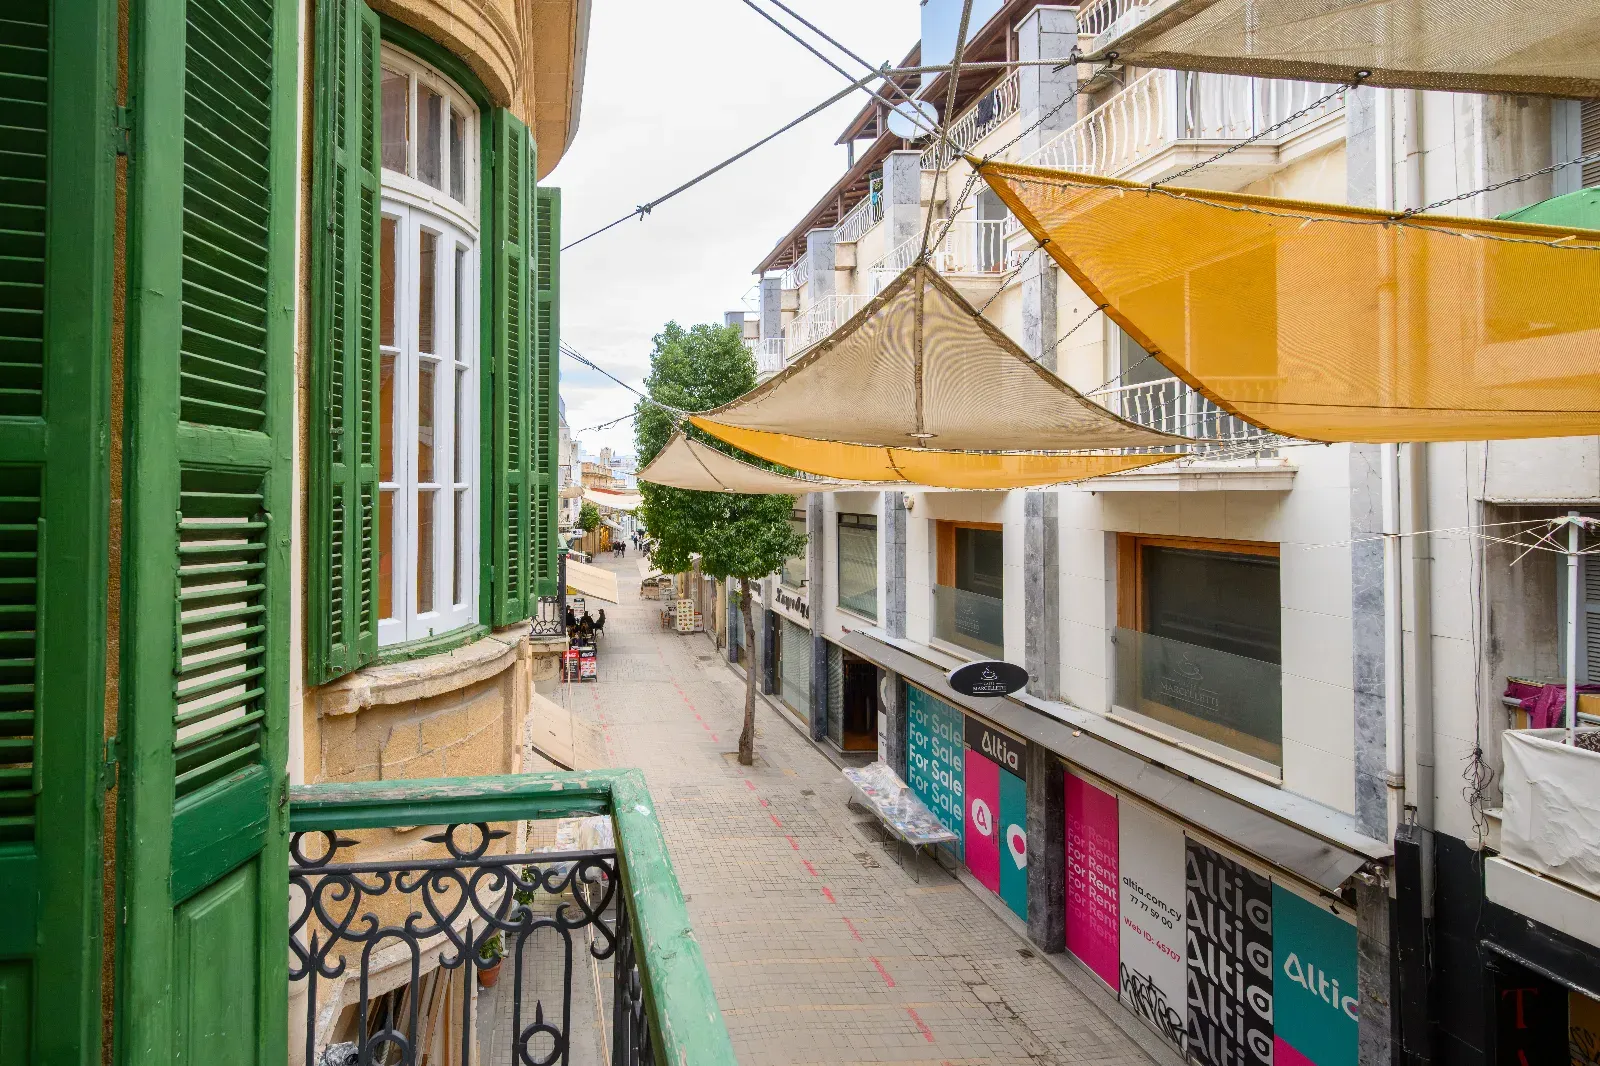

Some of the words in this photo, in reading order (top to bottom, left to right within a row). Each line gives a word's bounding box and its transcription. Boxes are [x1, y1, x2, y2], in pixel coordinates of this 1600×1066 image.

[910, 701, 928, 727] For
[932, 713, 962, 748] Sale
[910, 722, 928, 749] For
[932, 736, 962, 772] Sale
[910, 743, 928, 772] For
[932, 760, 962, 797] Sale
[981, 730, 1019, 770] Altia
[910, 765, 928, 795] For
[932, 782, 962, 821] Sale
[1068, 828, 1086, 848] For
[1088, 840, 1117, 870] Rent
[1068, 841, 1086, 863] For
[1088, 855, 1117, 885] Rent
[1068, 856, 1086, 878] For
[1088, 870, 1117, 901] Rent
[1068, 870, 1086, 892] For
[1088, 885, 1117, 916] Rent
[1122, 876, 1182, 921] altia.com.cy
[1187, 849, 1272, 936] Altia
[1068, 884, 1086, 907] For
[1088, 900, 1117, 932] Rent
[1130, 893, 1139, 905] 77
[1140, 901, 1149, 912] 77
[1150, 908, 1160, 919] 59
[1161, 916, 1173, 929] 00
[1123, 915, 1142, 935] Web
[1144, 930, 1155, 945] ID:
[1156, 940, 1181, 963] 45707
[1187, 889, 1273, 981] Altia
[1187, 928, 1274, 1026] Altia
[1188, 967, 1274, 1066] Altia
